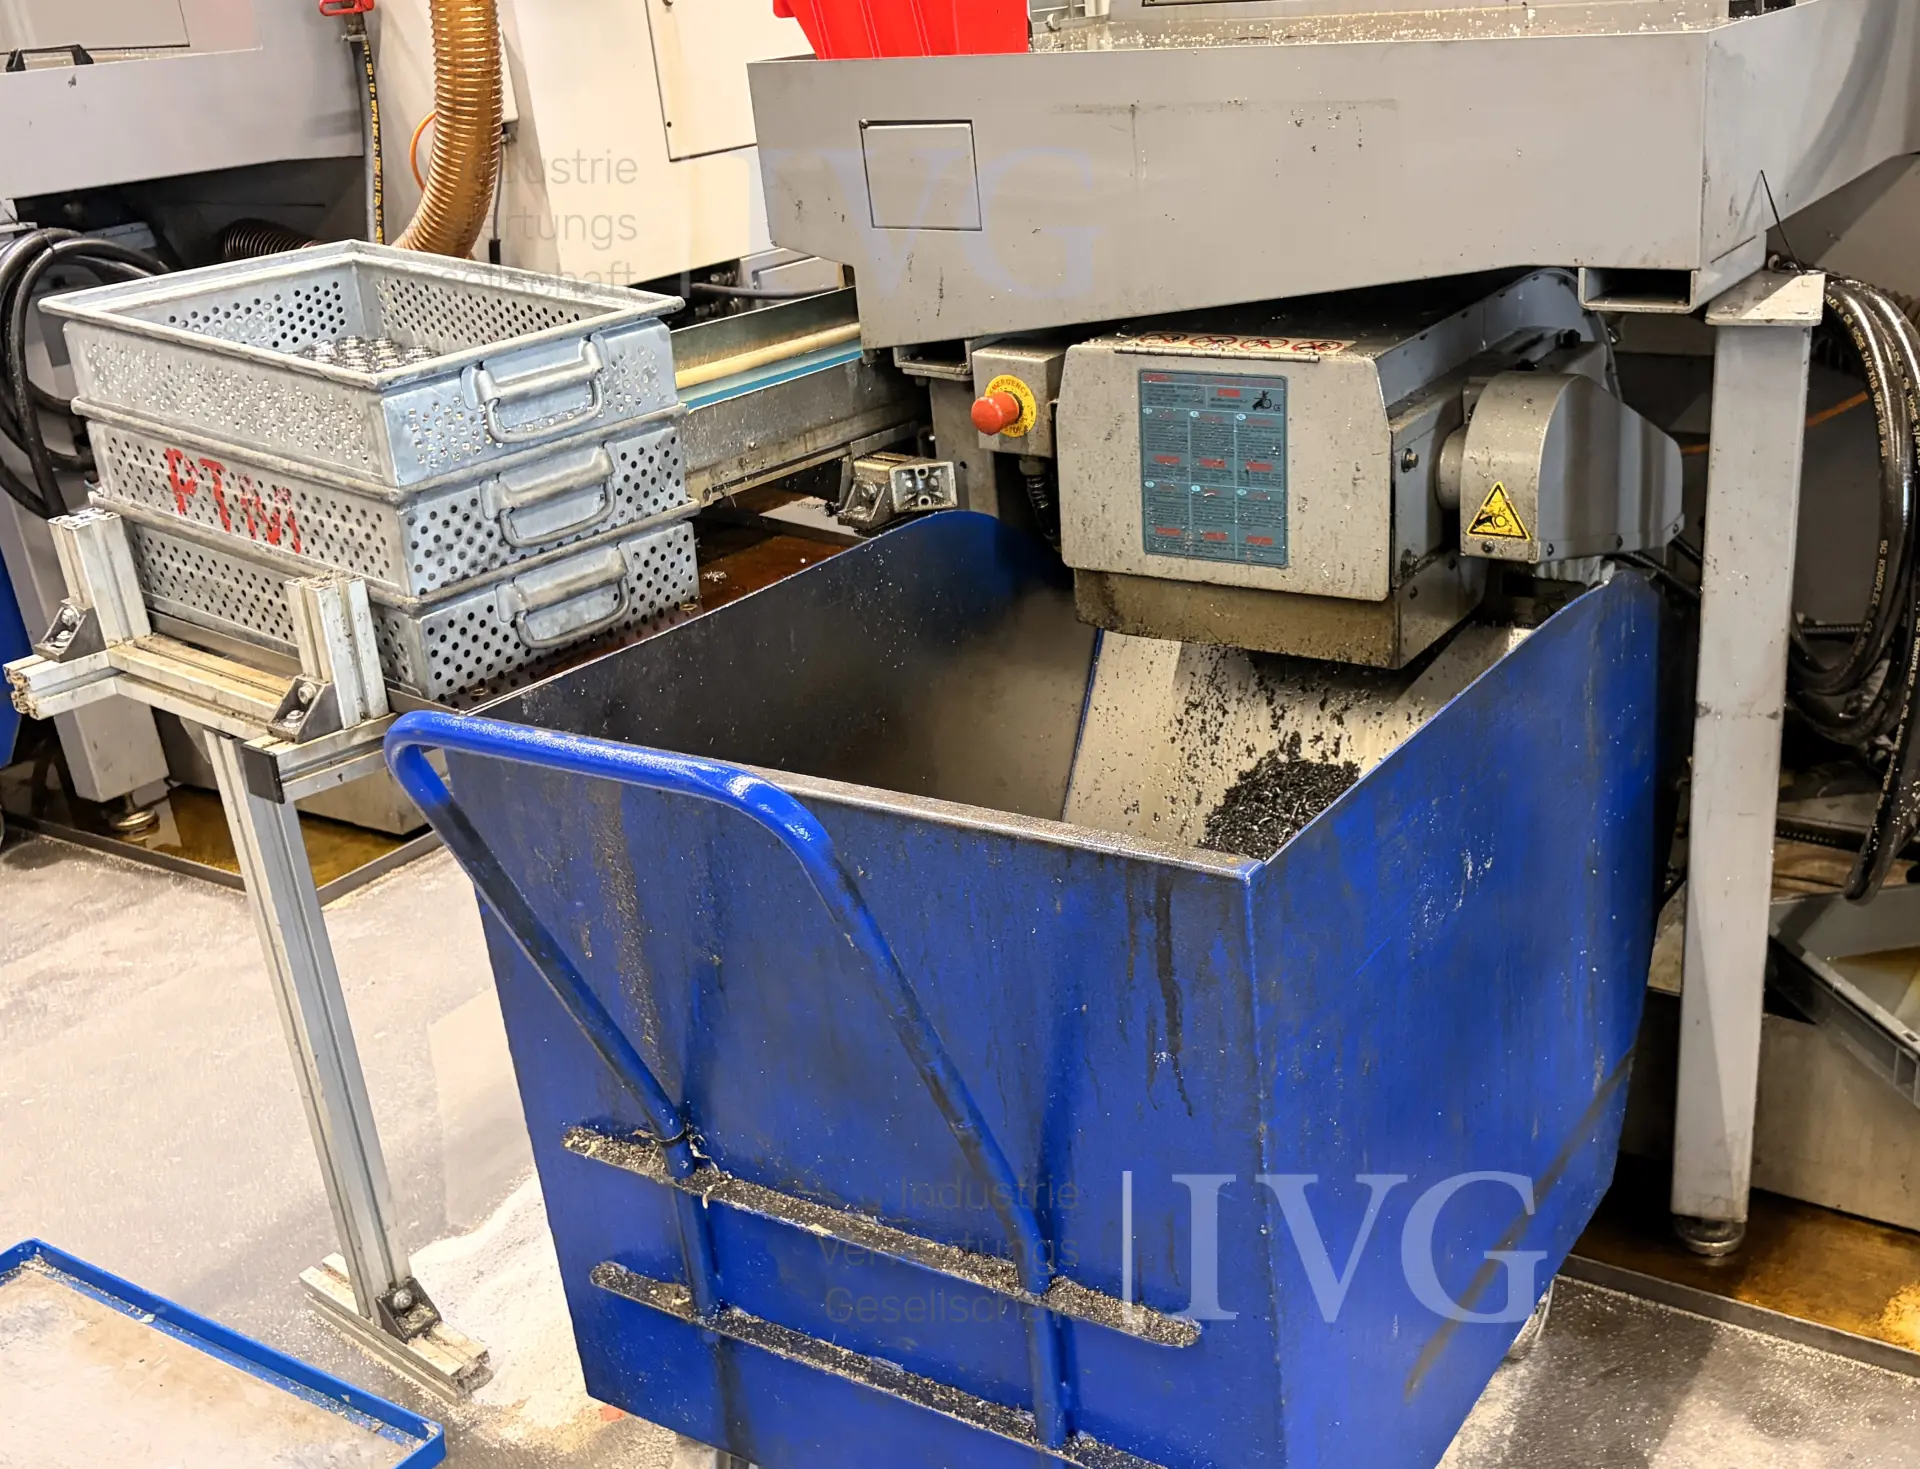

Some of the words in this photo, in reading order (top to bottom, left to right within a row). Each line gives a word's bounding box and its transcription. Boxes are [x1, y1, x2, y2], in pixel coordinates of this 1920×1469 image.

[988, 378, 1030, 398] EMERGENCY
[1879, 539, 1888, 554] SC
[1871, 558, 1886, 606] KINGFLEX
